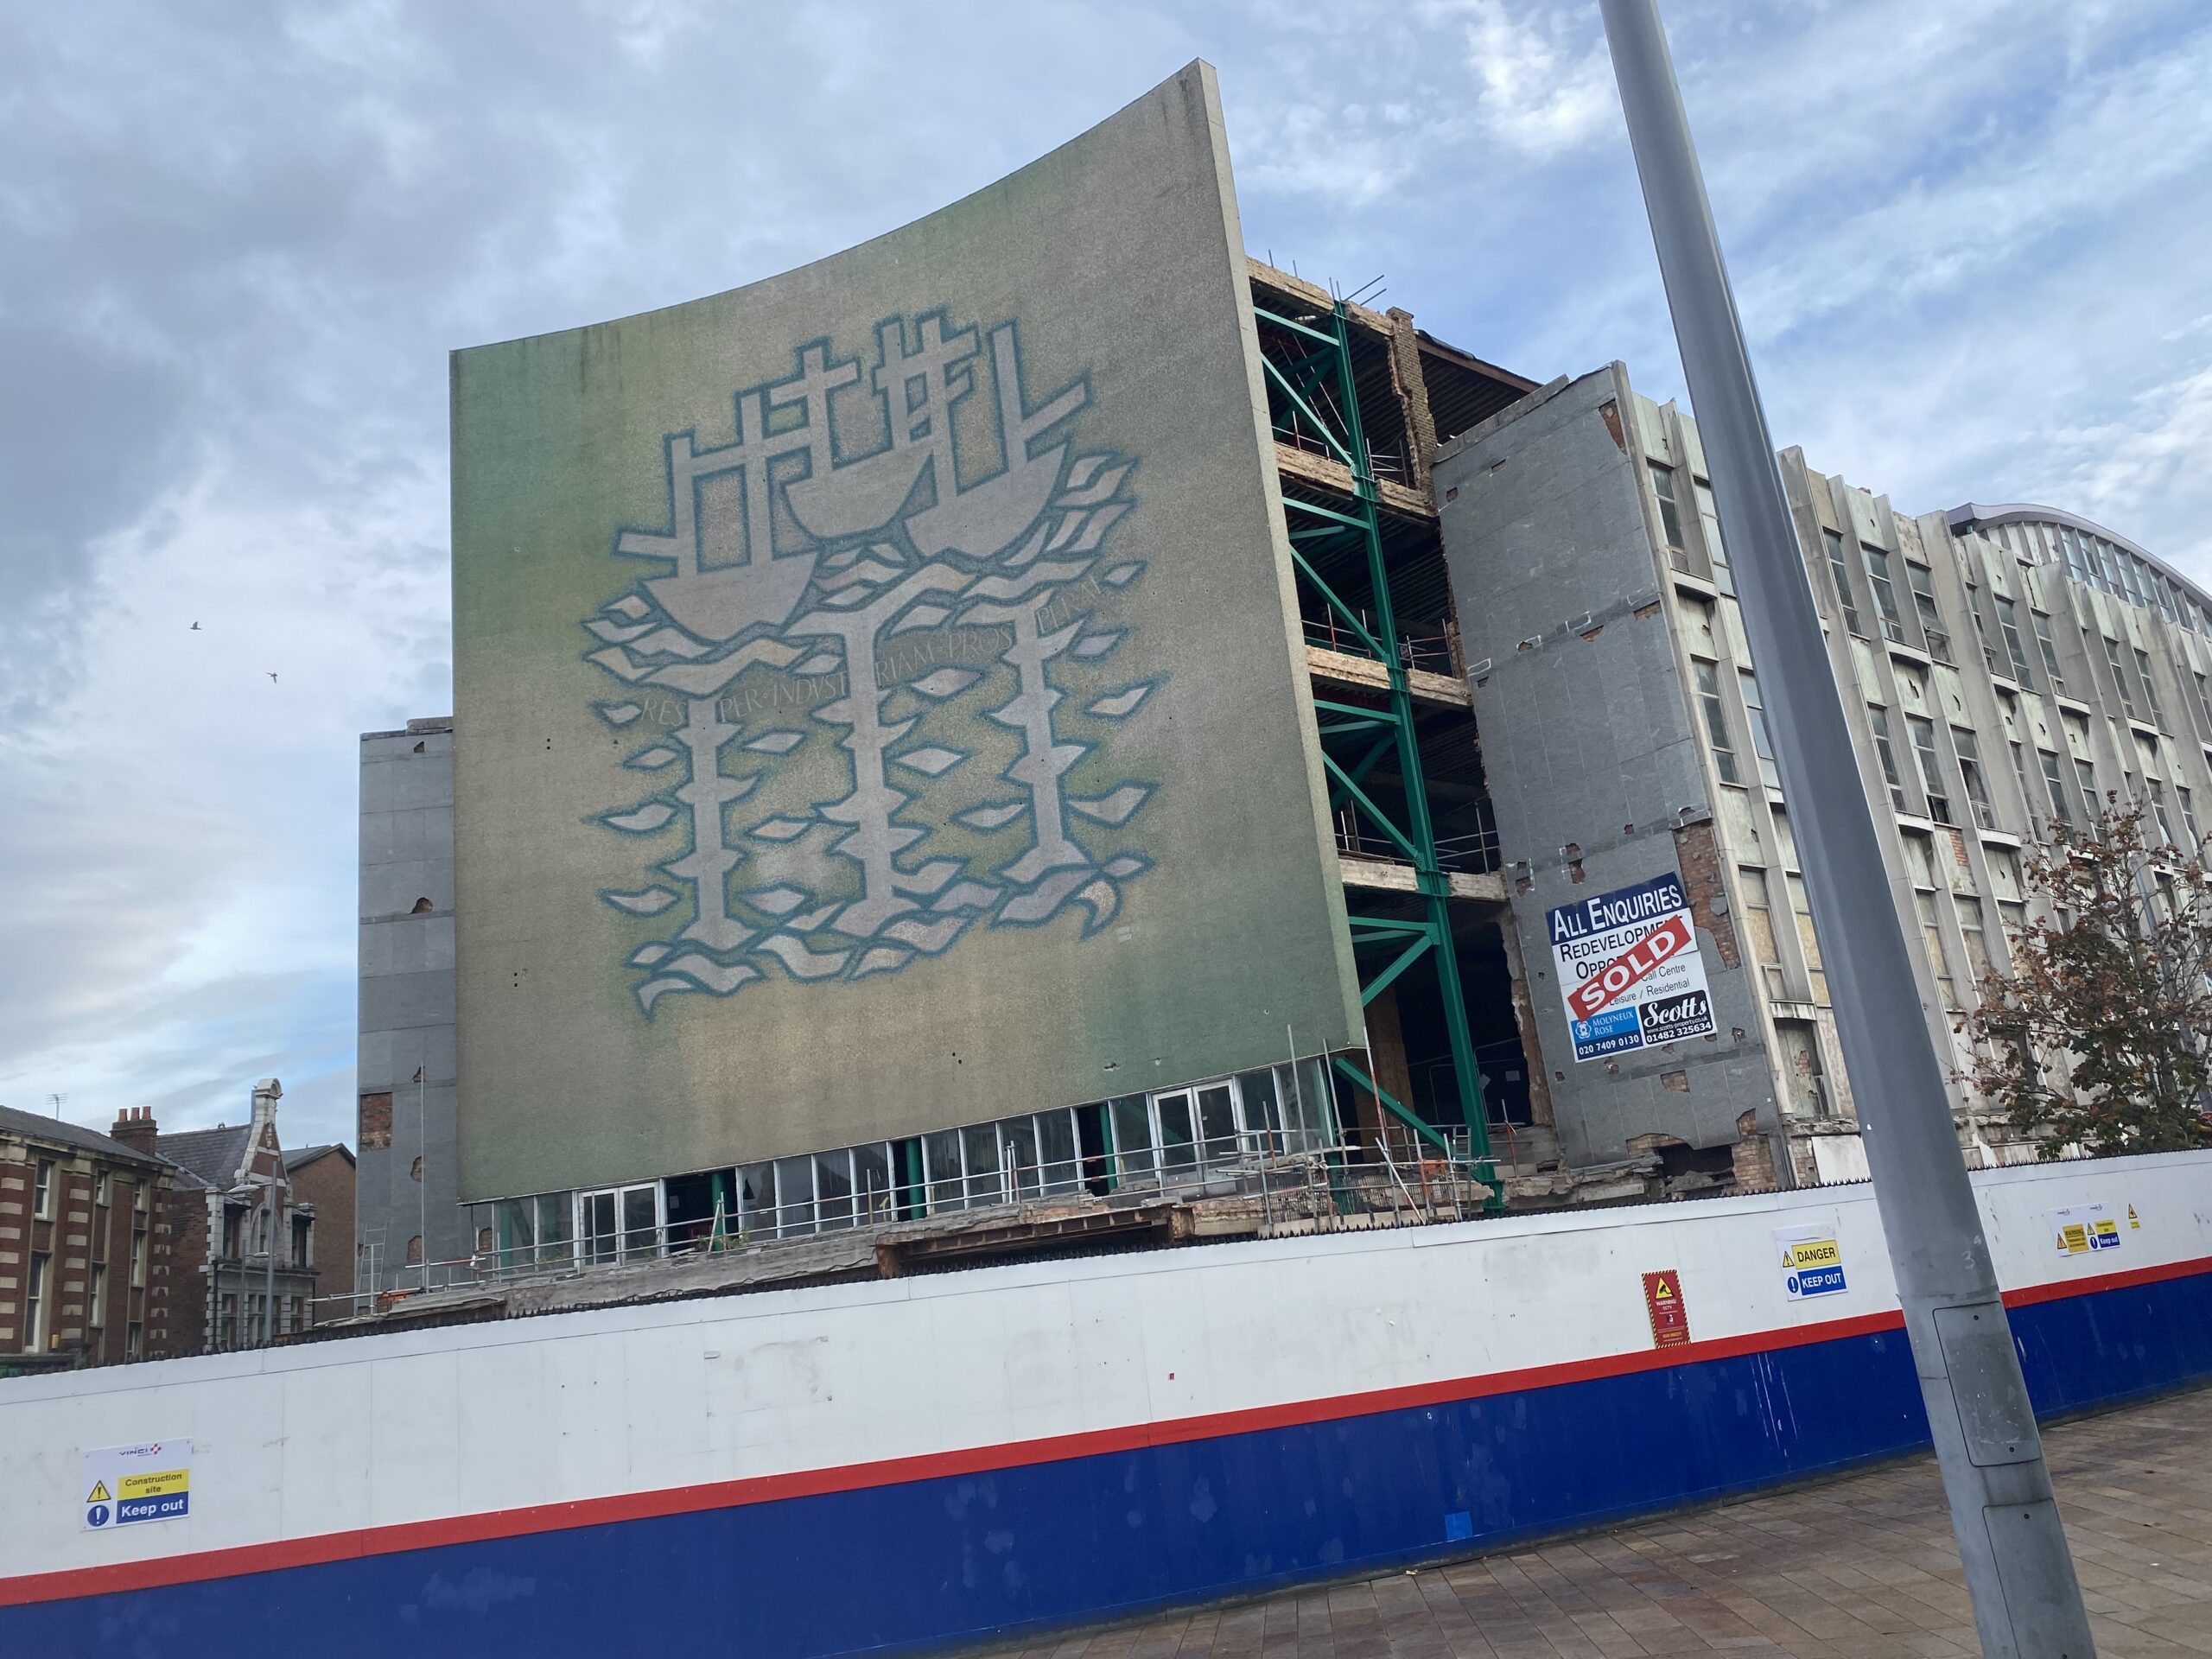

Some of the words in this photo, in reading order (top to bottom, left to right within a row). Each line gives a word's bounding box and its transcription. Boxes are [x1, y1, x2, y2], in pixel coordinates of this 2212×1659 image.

[640, 696, 686, 727] RES
[718, 687, 764, 723] PER
[1554, 908, 1589, 942] ALL
[1587, 884, 1682, 932] ENQUIRIES
[1580, 930, 1675, 1011] SOLD
[1658, 963, 1686, 977] Centre
[1609, 991, 1637, 1007] Leisure
[1646, 978, 1690, 996] Residential
[1592, 1010, 1634, 1027] MOLYNEUX
[1643, 996, 1707, 1027] Scotts
[1594, 1026, 1614, 1036] ROSE
[1646, 1016, 1708, 1034] www.scotts-property.co.uk
[1646, 1031, 1675, 1043] 01482
[1677, 1020, 1712, 1037] 325634
[1579, 1045, 1594, 1055] 020
[1596, 1039, 1616, 1052] 7409
[1618, 1034, 1639, 1046] 0130
[1796, 1247, 1836, 1262] DANGER
[1802, 1274, 1823, 1289] KEEP
[1825, 1273, 1841, 1285] OUT
[125, 1473, 182, 1486] Construction
[145, 1485, 162, 1494] site
[121, 1504, 156, 1517] Keep
[162, 1499, 184, 1511] out
